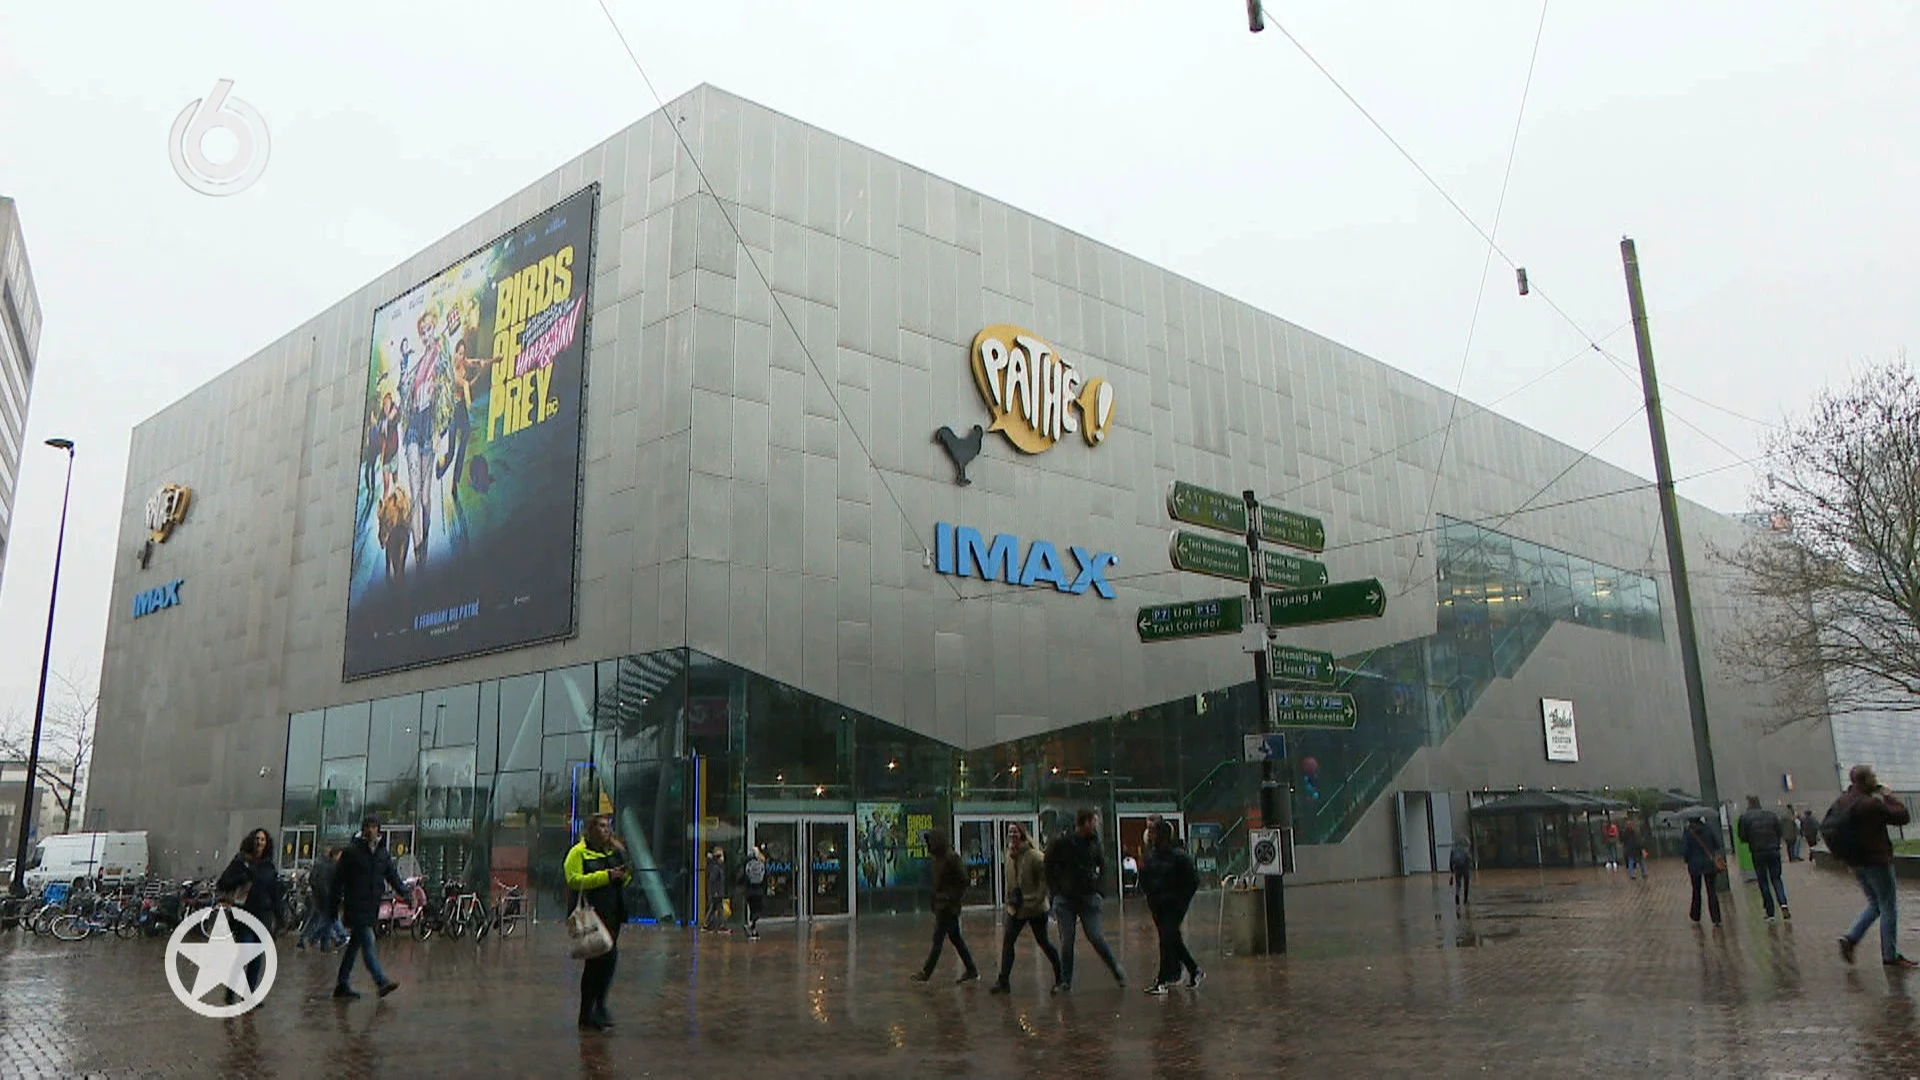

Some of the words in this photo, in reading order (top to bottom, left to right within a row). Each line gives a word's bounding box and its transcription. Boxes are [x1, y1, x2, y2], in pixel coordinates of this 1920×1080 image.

[494, 245, 574, 331] BIRDS
[490, 319, 528, 384] OF
[487, 363, 553, 442] PREY
[936, 522, 1119, 599] IMAX
[132, 577, 184, 619] IMAX
[1271, 594, 1309, 607] Ingang
[1312, 590, 1322, 601] M
[1174, 607, 1192, 617] t/m
[1153, 623, 1173, 634] Taxi
[1176, 619, 1220, 631] Corridor
[1280, 711, 1294, 719] Taxi
[421, 818, 472, 830] SURINAME
[907, 814, 932, 830] BIRDS
